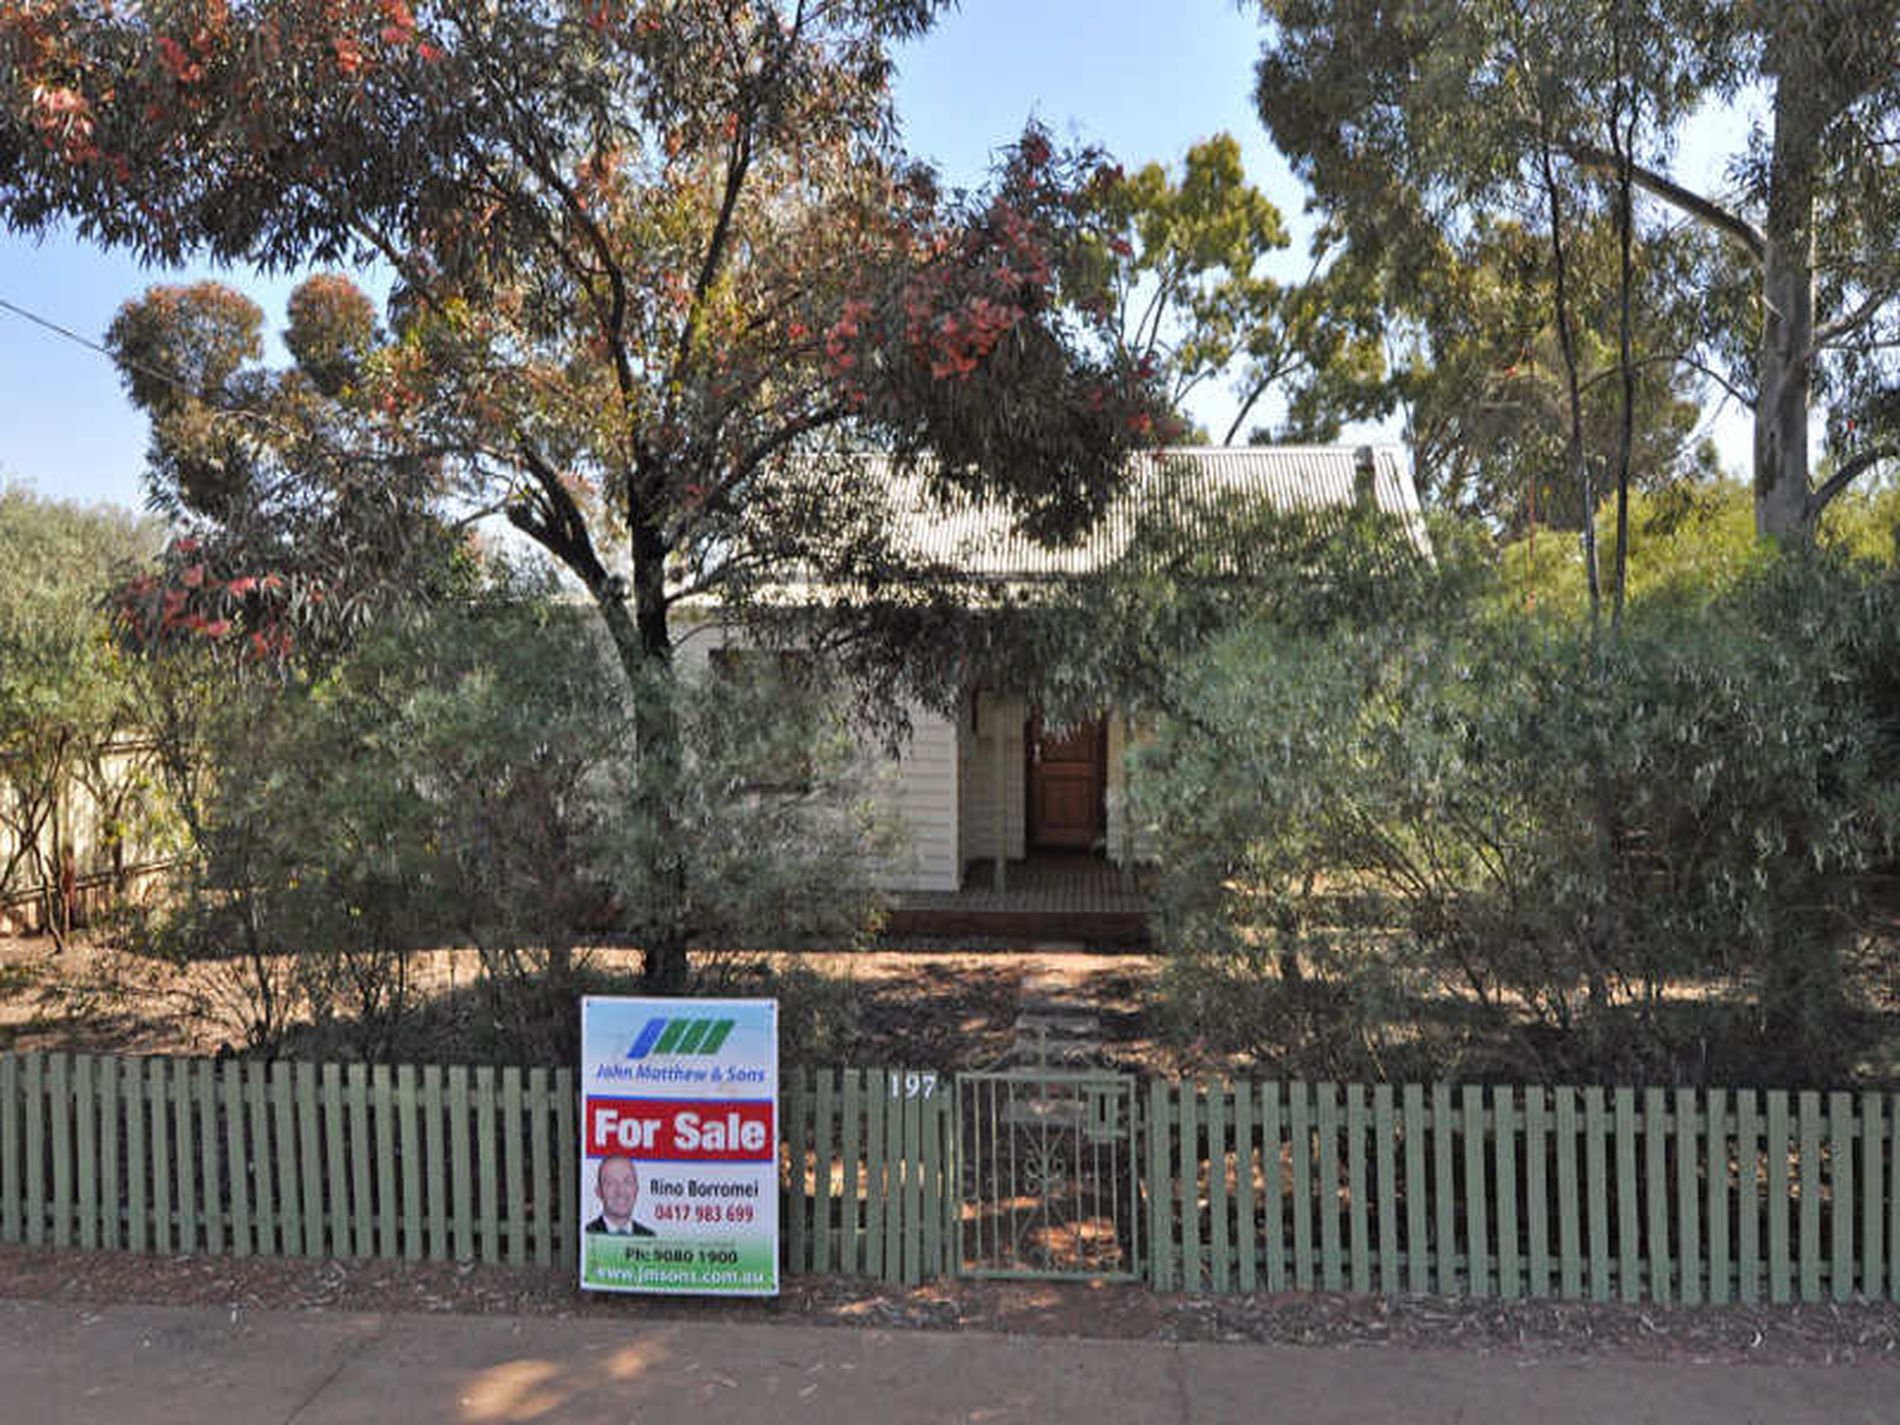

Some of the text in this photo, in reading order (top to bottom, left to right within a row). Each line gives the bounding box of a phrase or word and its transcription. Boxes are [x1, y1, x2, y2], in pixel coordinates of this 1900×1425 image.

[596, 1064, 765, 1083] John Matthew & Sons
[891, 1074, 937, 1099] 197
[595, 1108, 766, 1151] For Sale
[650, 1179, 759, 1198] Rino Borromei
[655, 1204, 754, 1223] 0417 983 699
[698, 1250, 738, 1265] 1900
